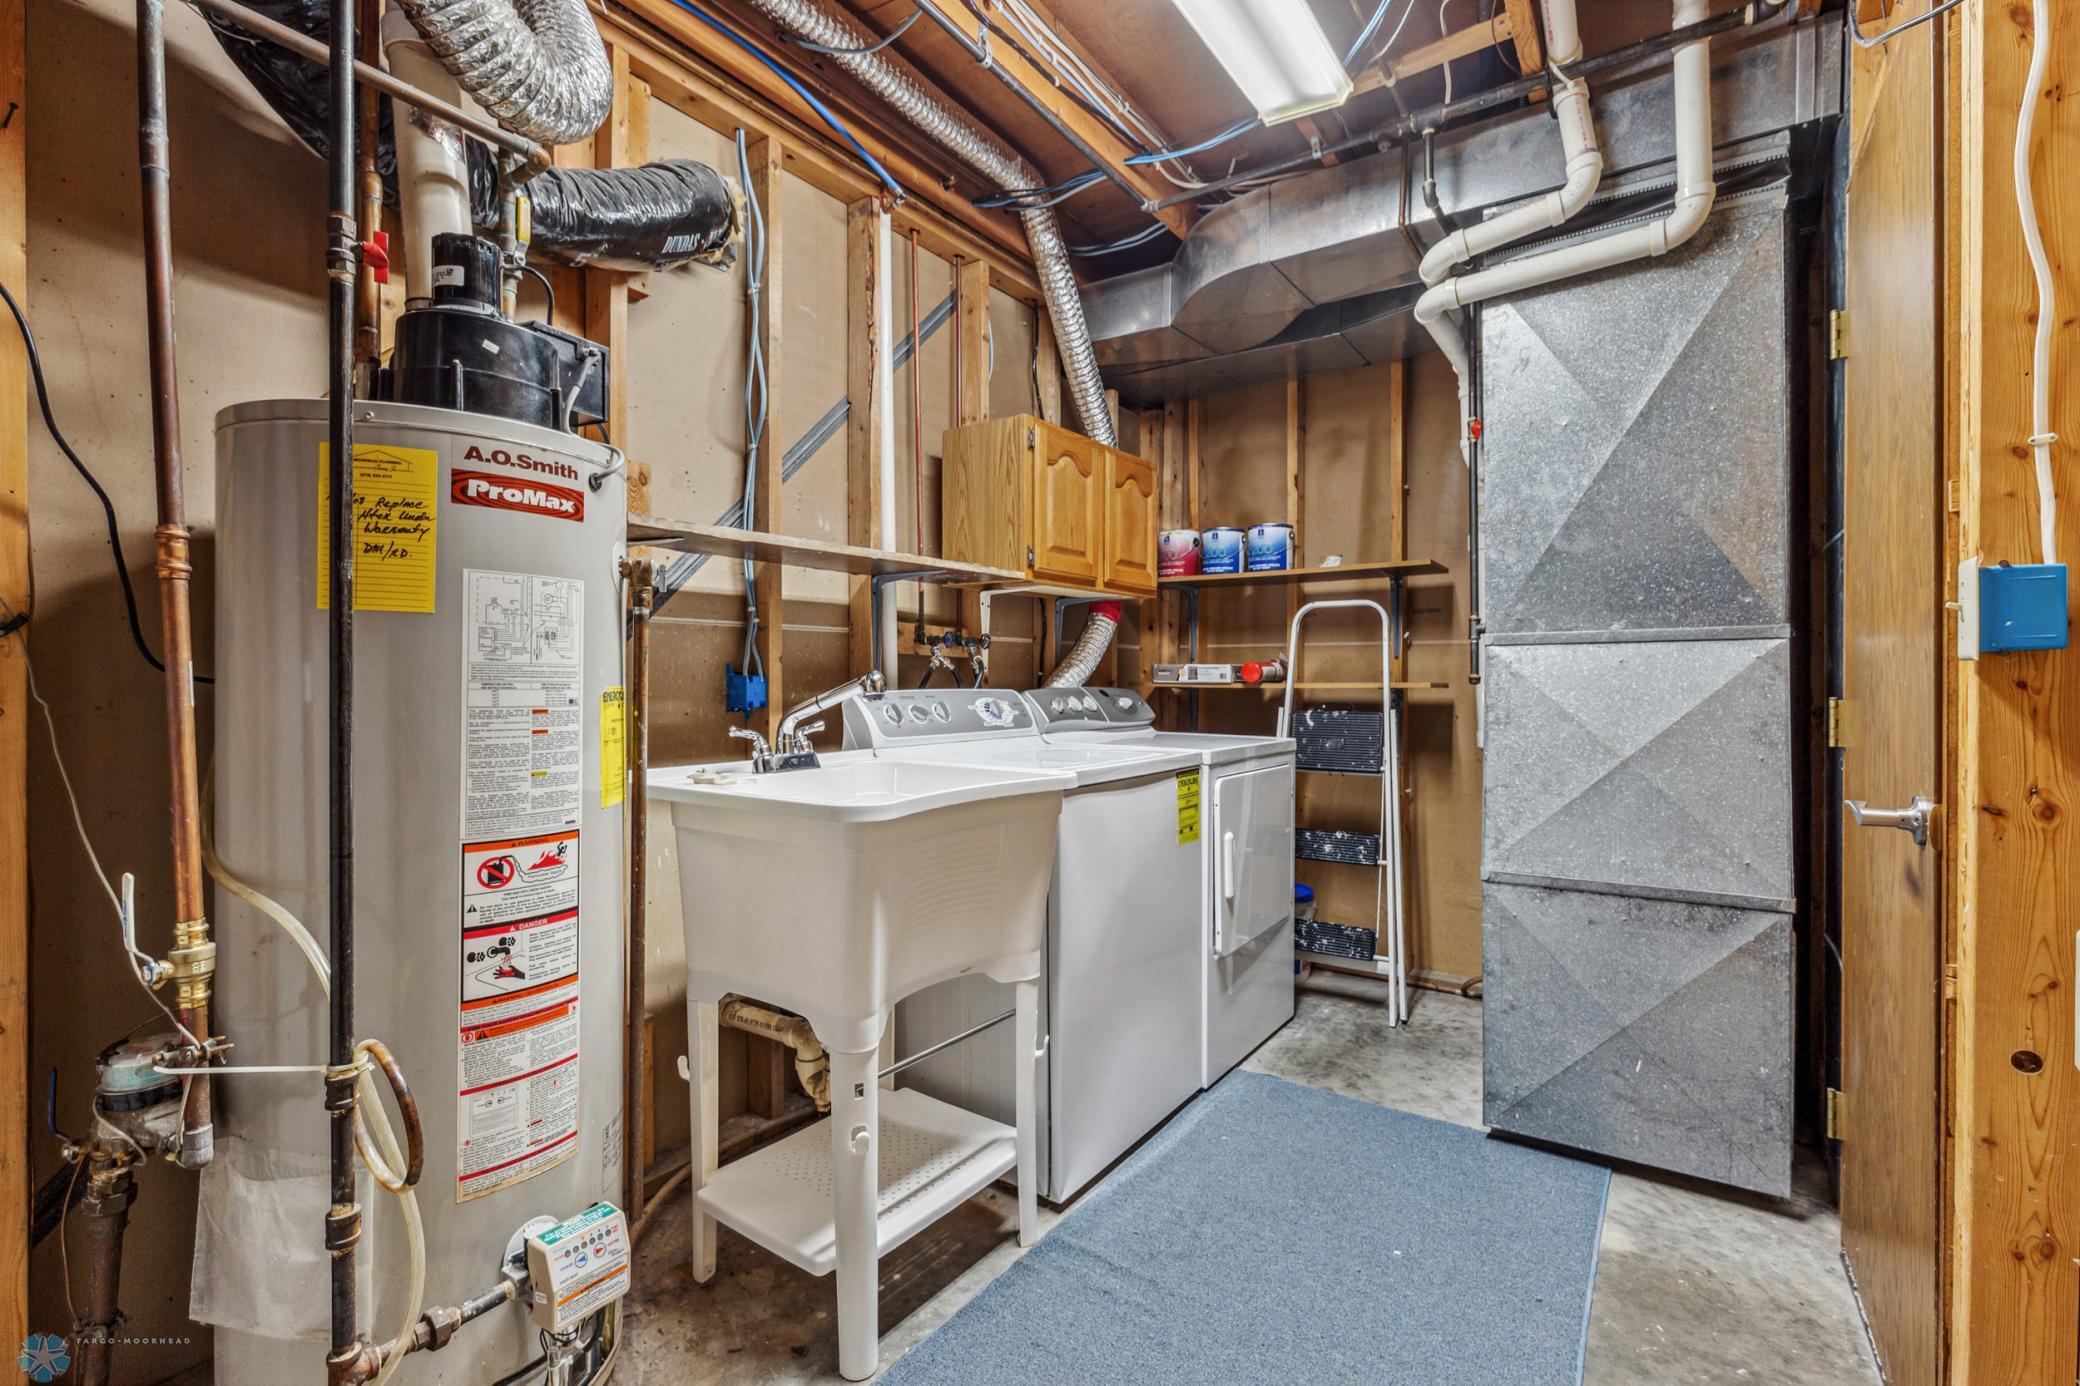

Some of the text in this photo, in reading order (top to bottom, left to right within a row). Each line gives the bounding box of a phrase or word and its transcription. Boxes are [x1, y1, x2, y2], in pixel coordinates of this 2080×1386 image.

[661, 233, 701, 254] DUNDAS
[375, 496, 428, 512] Replace
[467, 479, 576, 513] ProMax
[519, 918, 549, 930] DANGER
